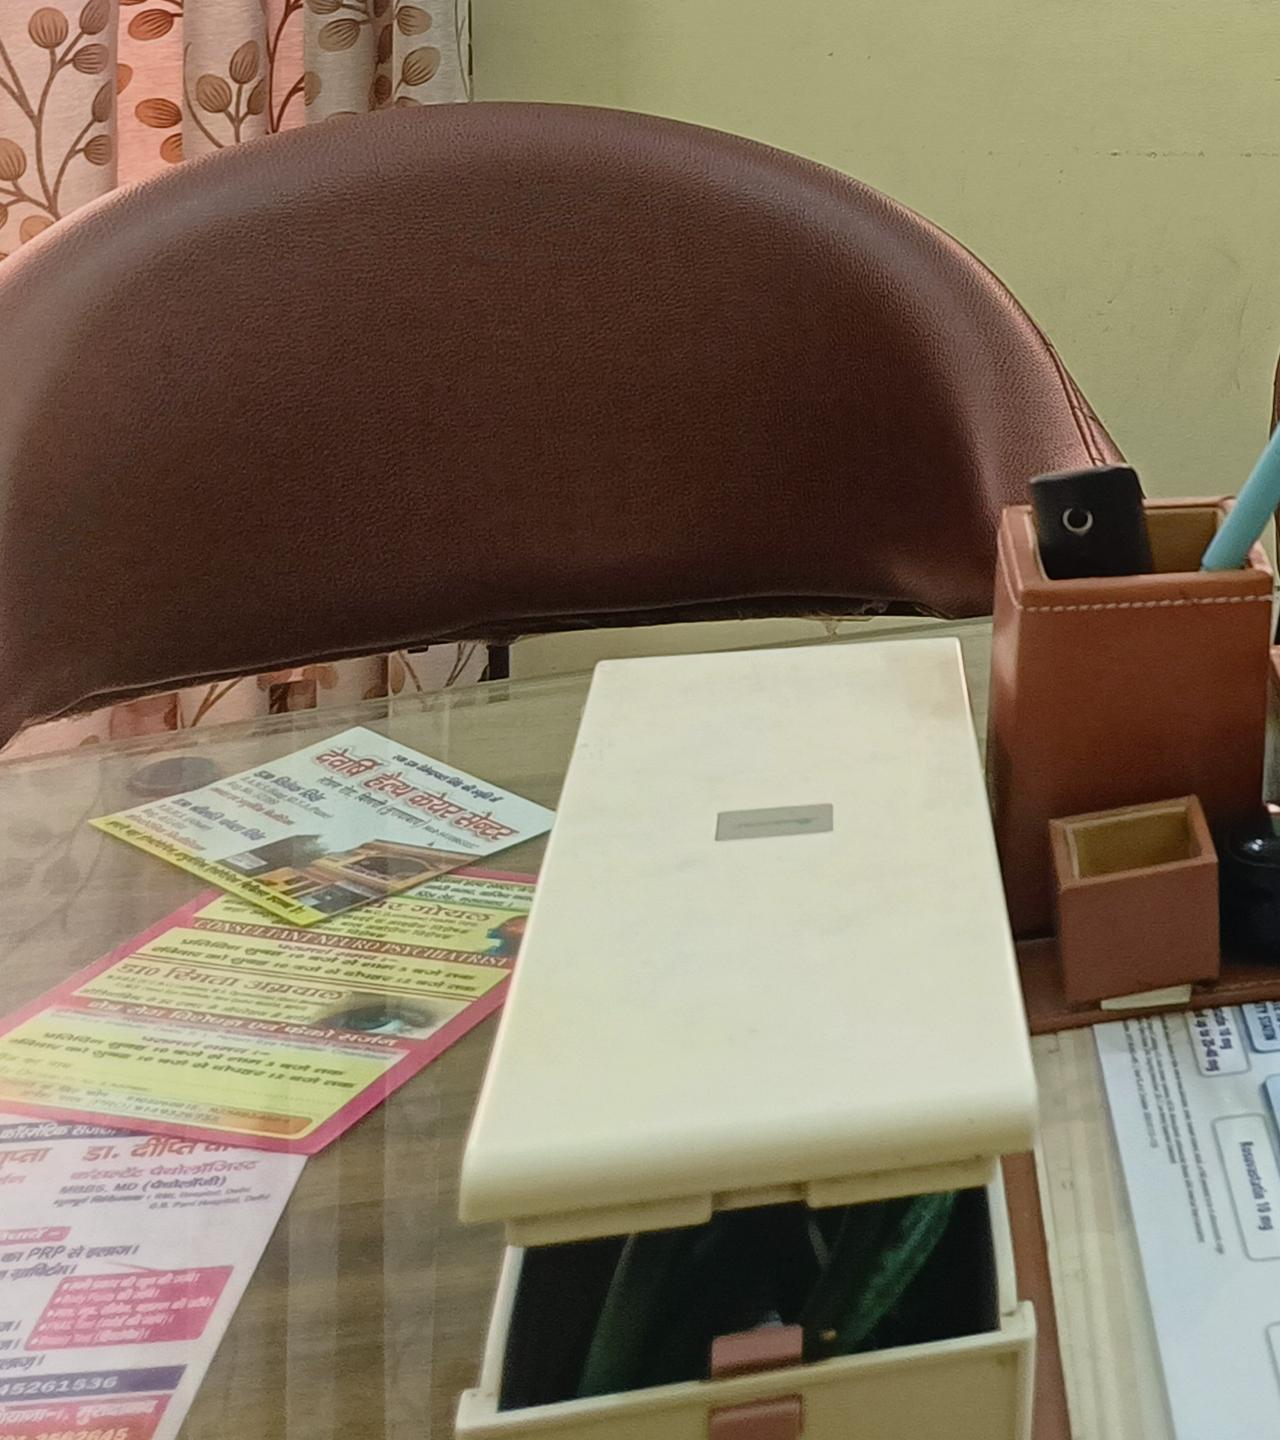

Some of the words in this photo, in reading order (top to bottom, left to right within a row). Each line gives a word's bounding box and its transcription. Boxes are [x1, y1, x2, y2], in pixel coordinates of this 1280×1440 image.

[405, 791, 468, 820] केयर
[194, 917, 314, 946] CONSULTANT
[314, 930, 384, 953] NEURO
[383, 941, 508, 968] PSYCHIATRIST
[243, 976, 348, 1001] अग्रवाल
[82, 1145, 119, 1160] डा.
[1239, 1141, 1265, 1200] Rosuvastatin
[113, 1182, 139, 1192] MD
[1256, 1200, 1272, 1215] 10
[1258, 1214, 1275, 1234] mg
[27, 1246, 67, 1259] PRP
